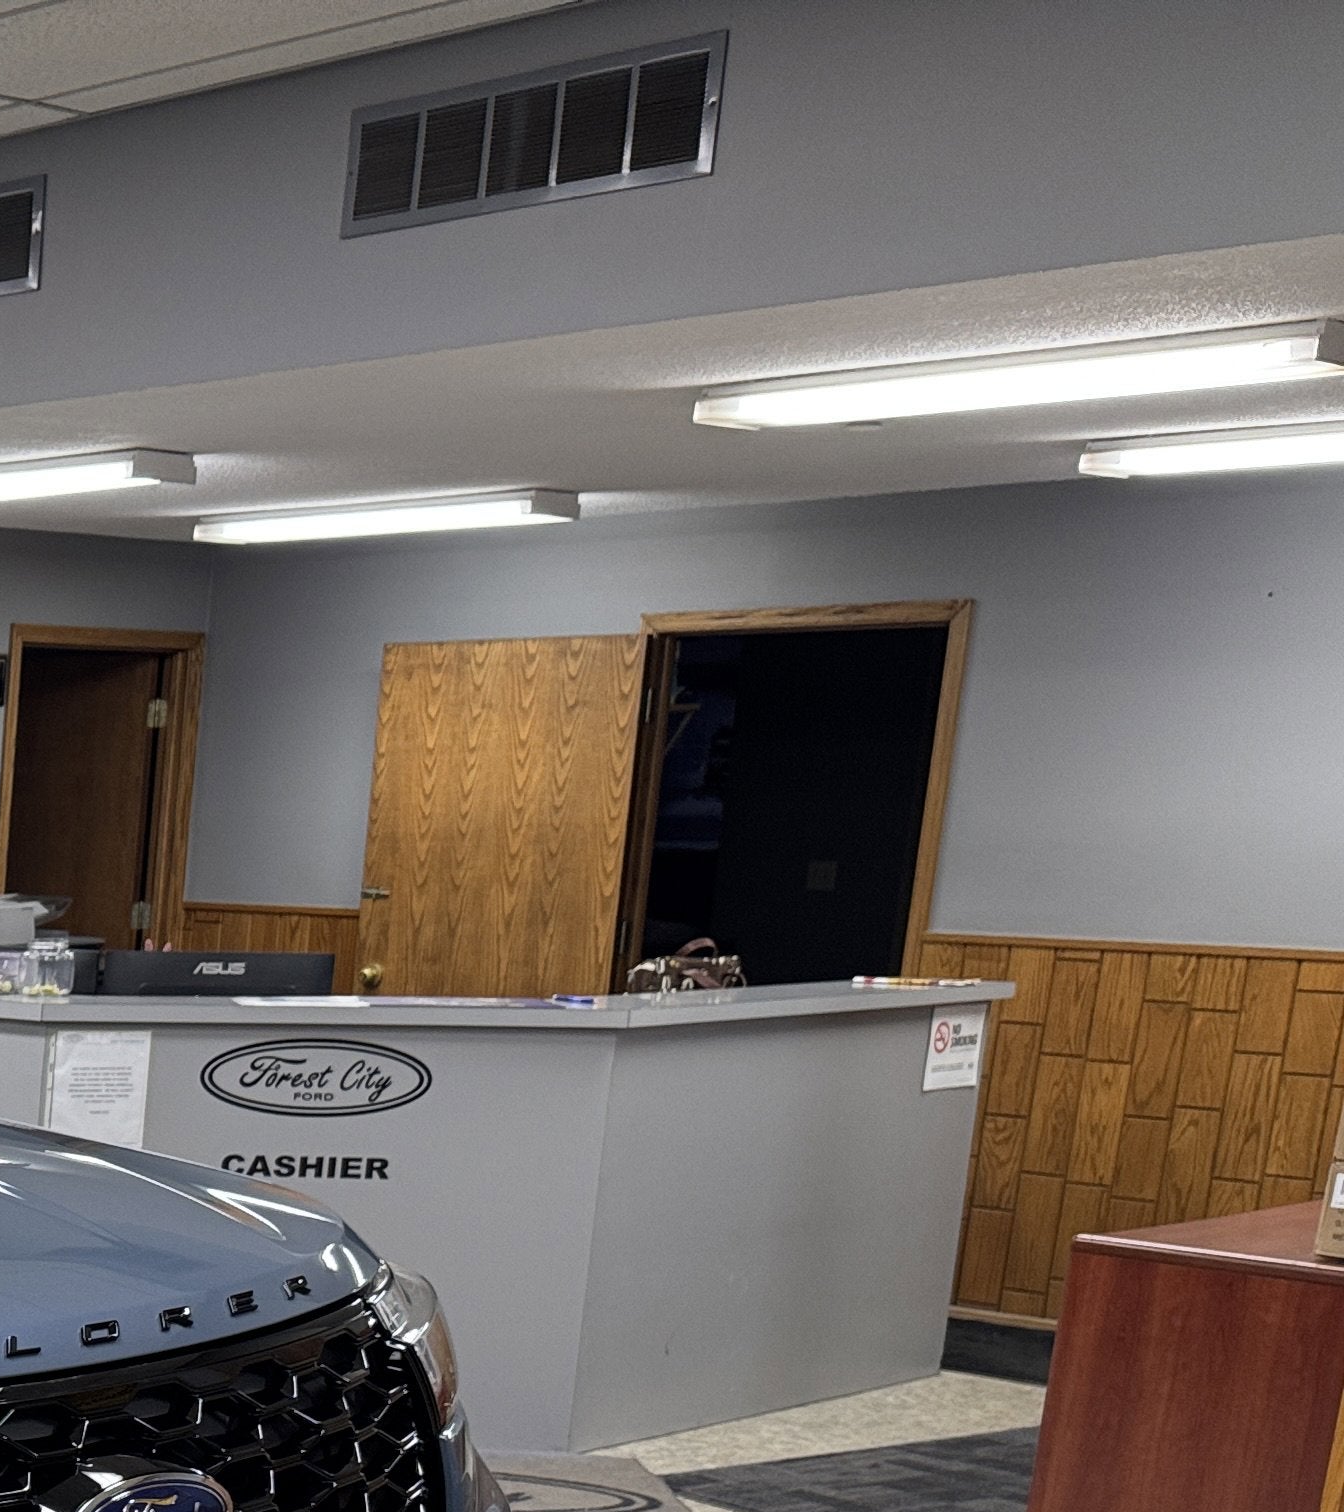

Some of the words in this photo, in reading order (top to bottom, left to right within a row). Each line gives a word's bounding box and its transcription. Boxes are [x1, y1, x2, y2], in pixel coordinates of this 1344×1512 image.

[193, 962, 246, 975] ASUS
[239, 1056, 333, 1088] Forest
[340, 1060, 392, 1103] City
[293, 1092, 334, 1102] FORD
[221, 1154, 389, 1180] CASHIER
